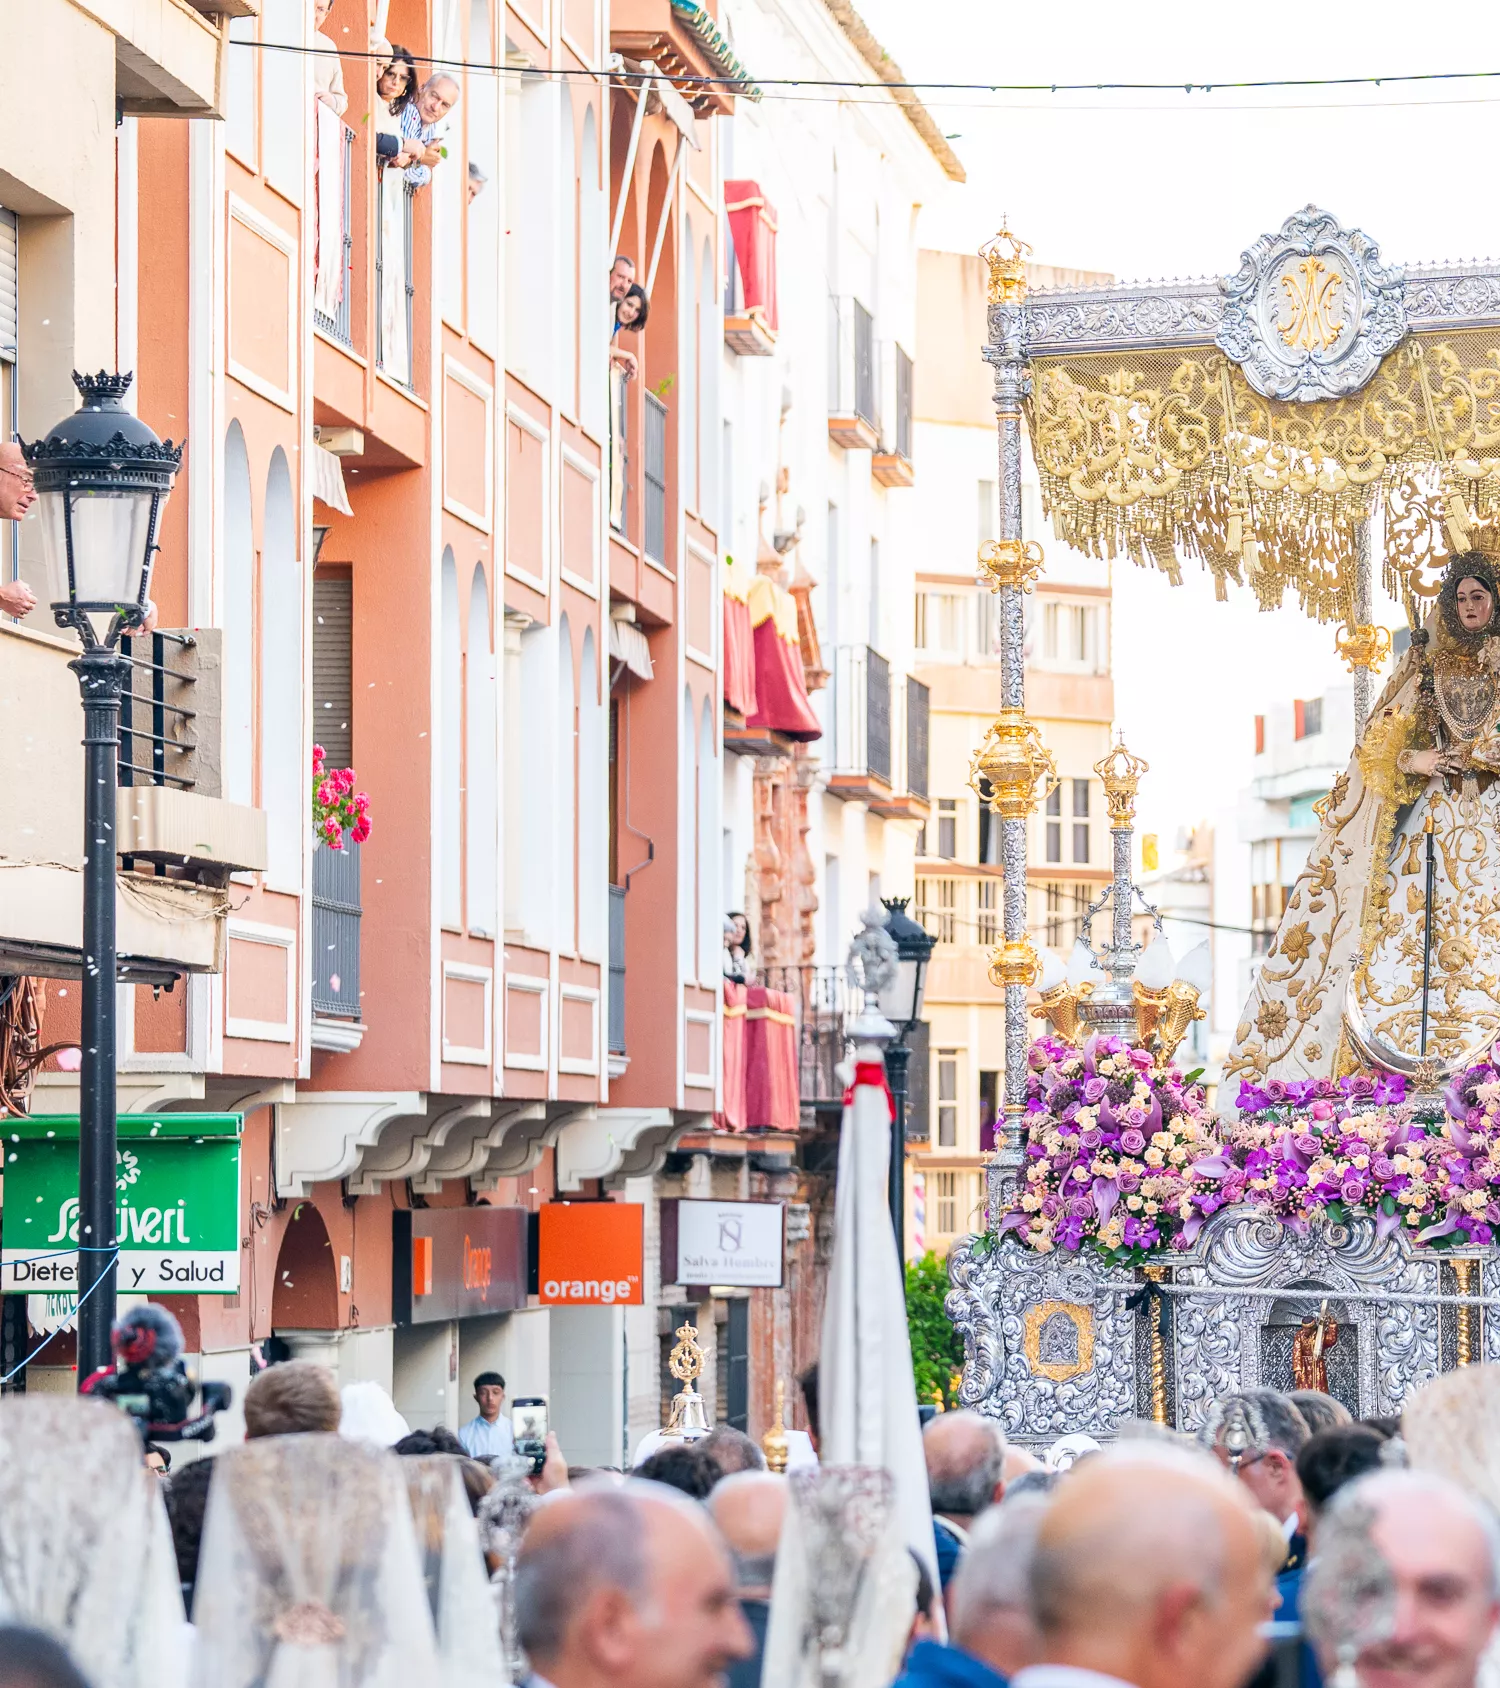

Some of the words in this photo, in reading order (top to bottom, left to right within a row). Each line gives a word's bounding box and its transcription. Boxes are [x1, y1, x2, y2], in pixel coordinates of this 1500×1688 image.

[48, 1197, 190, 1243] Saiveri
[131, 1267, 146, 1288] y
[158, 1258, 224, 1282] Salud
[544, 1280, 631, 1303] orange
